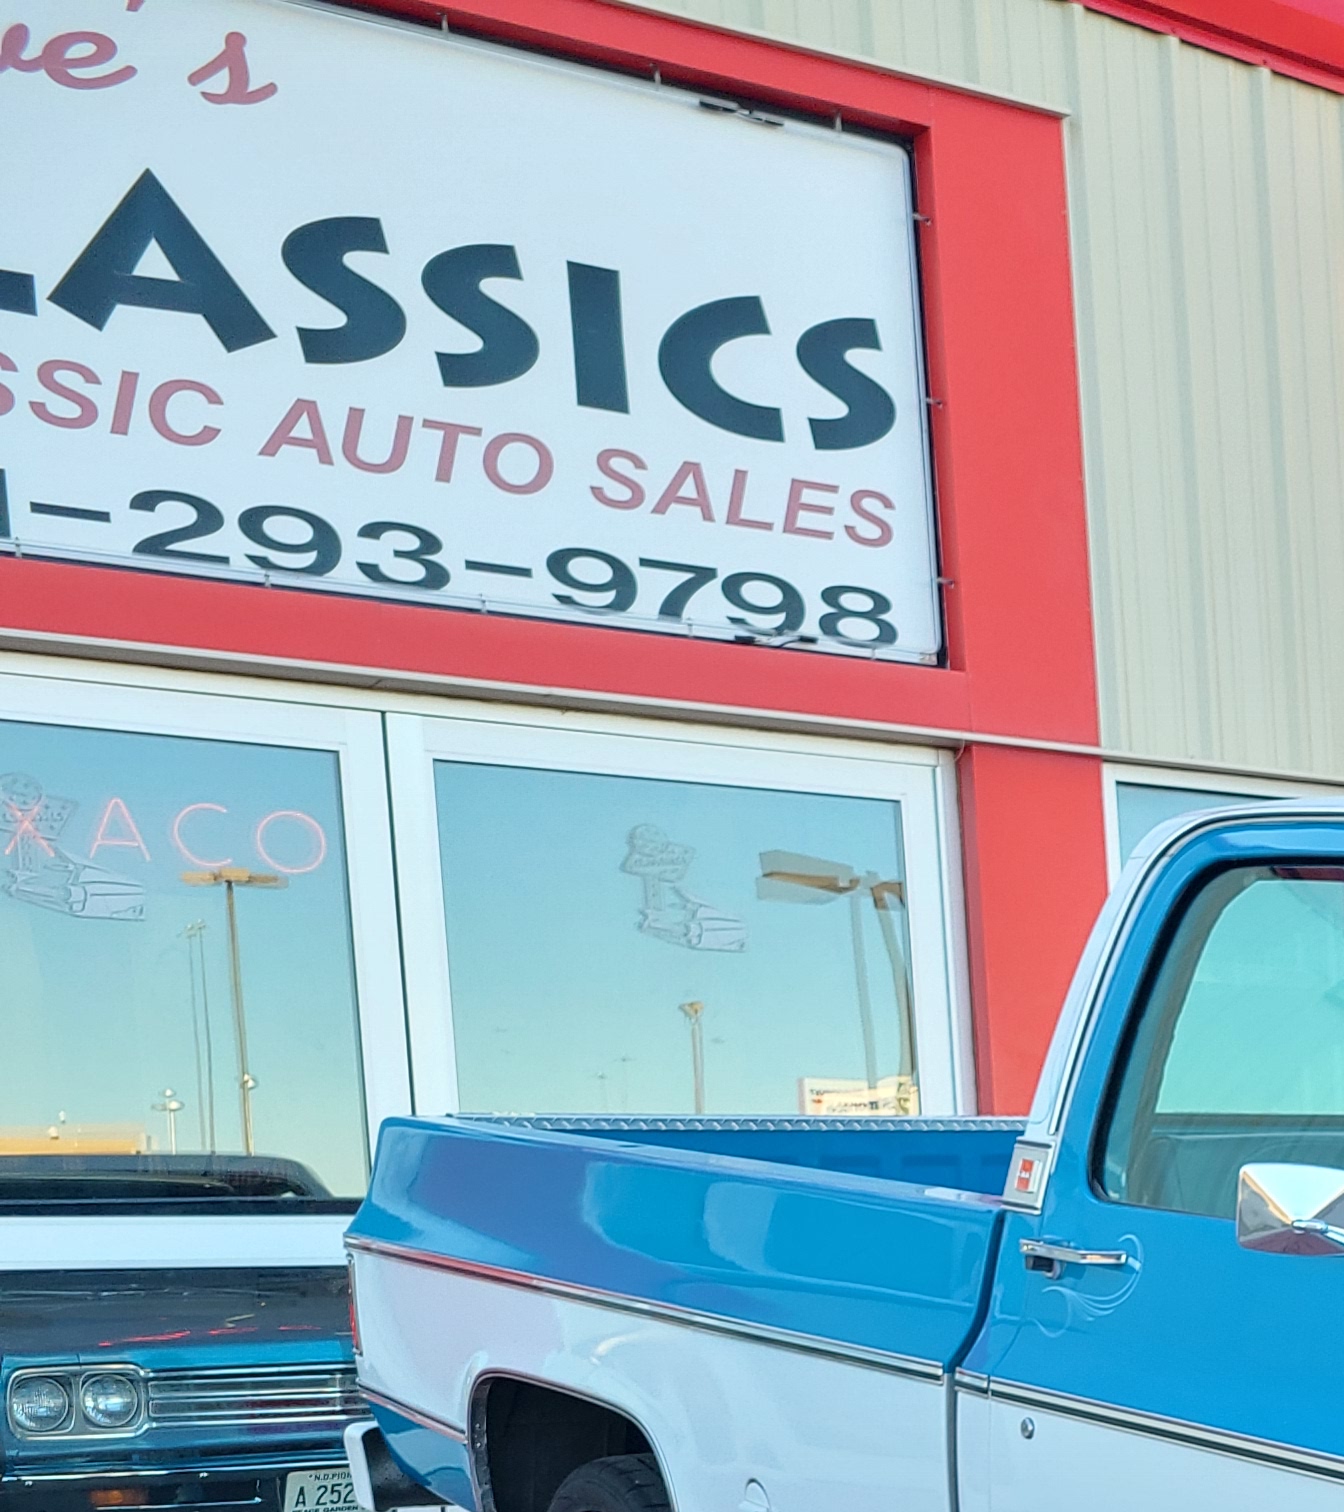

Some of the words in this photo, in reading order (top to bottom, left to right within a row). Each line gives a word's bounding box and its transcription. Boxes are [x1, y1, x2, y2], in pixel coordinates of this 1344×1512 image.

[258, 397, 554, 496] AUTO
[589, 448, 896, 548] SALES
[294, 1485, 307, 1508] A
[323, 1505, 359, 1512] GARDEN
